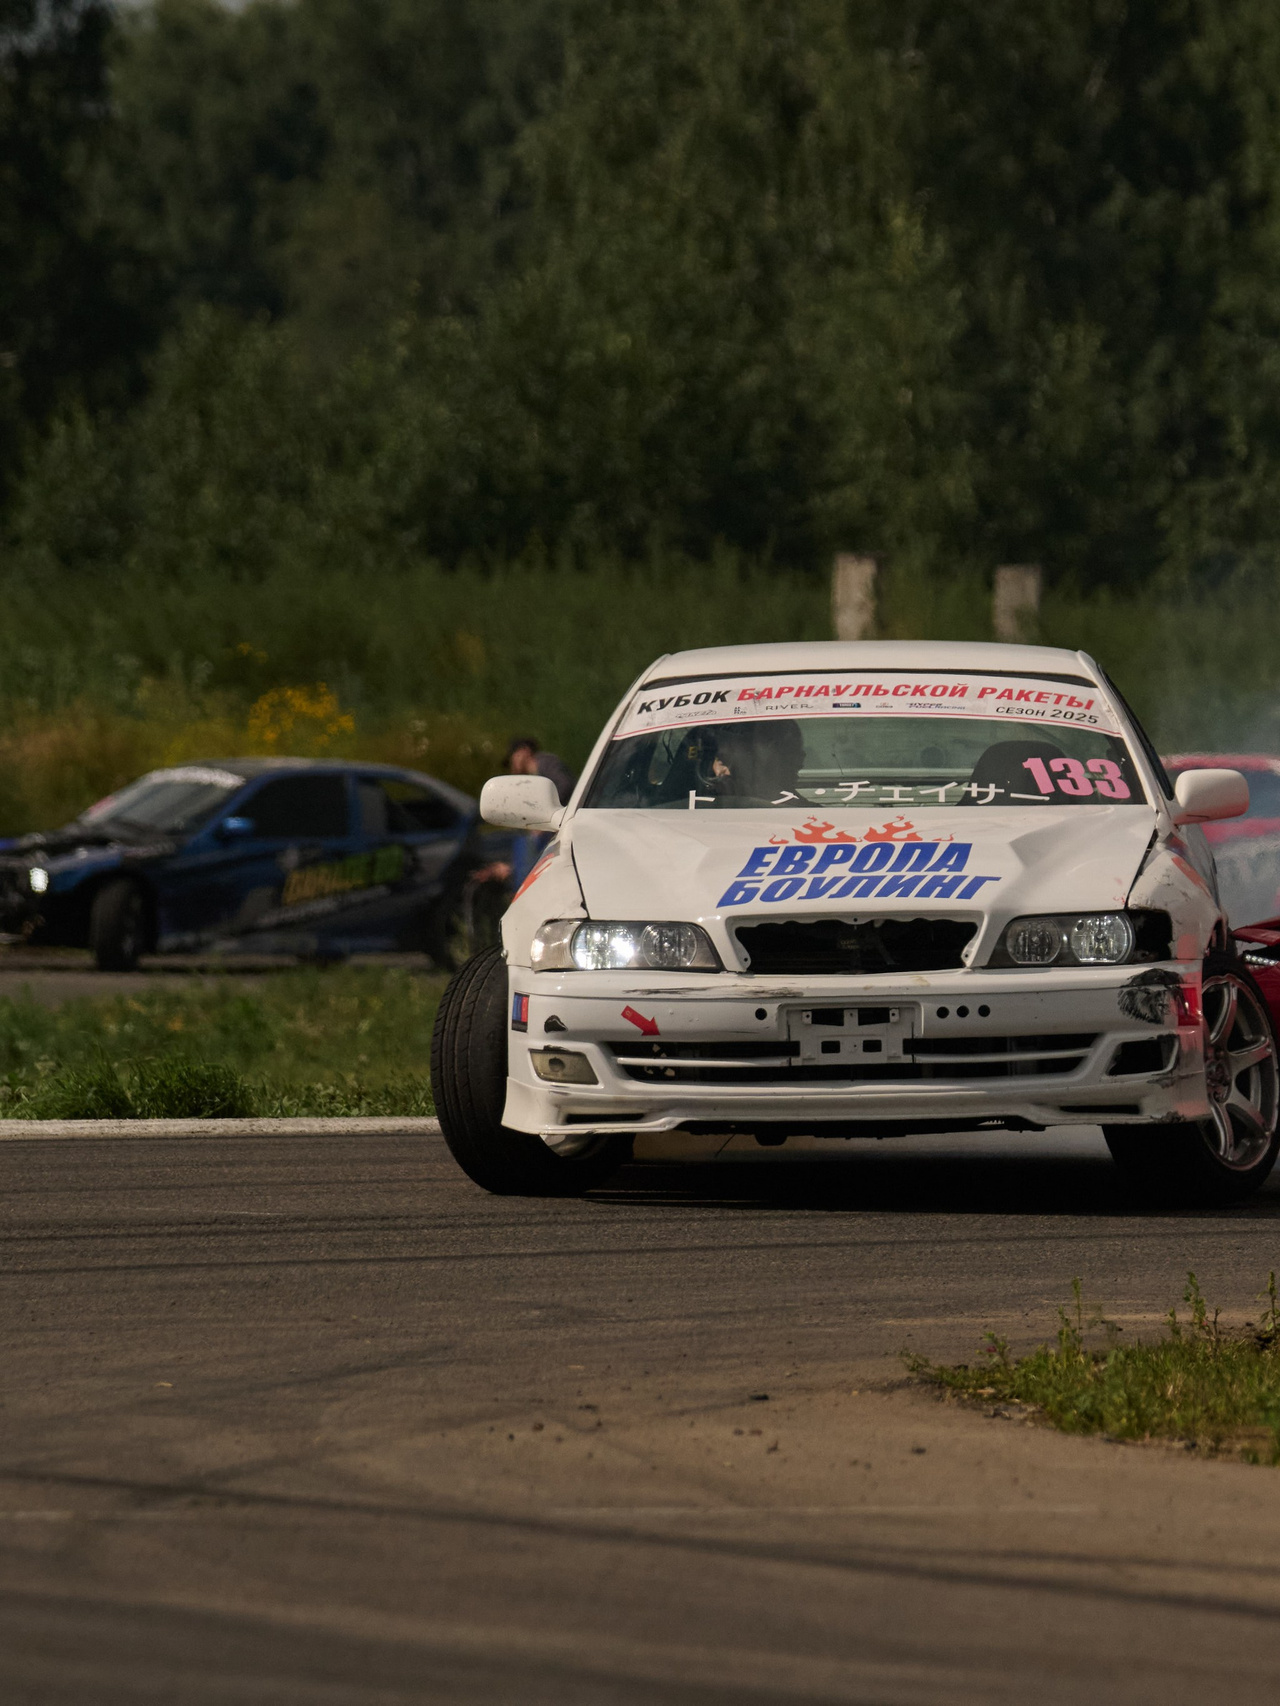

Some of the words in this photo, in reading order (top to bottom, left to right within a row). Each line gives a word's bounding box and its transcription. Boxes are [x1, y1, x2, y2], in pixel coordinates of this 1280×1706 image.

[637, 689, 732, 715] КУБОК
[737, 682, 969, 701] БАРНАУЛЬСКОЙ
[977, 687, 1095, 710] РАКЕТЫ
[995, 705, 1046, 717] СЕЗОН
[1049, 708, 1100, 724] 2025
[1022, 756, 1131, 799] 133
[736, 842, 973, 878] ЕВРОПА
[716, 875, 1002, 909] БОУЛИНГ
